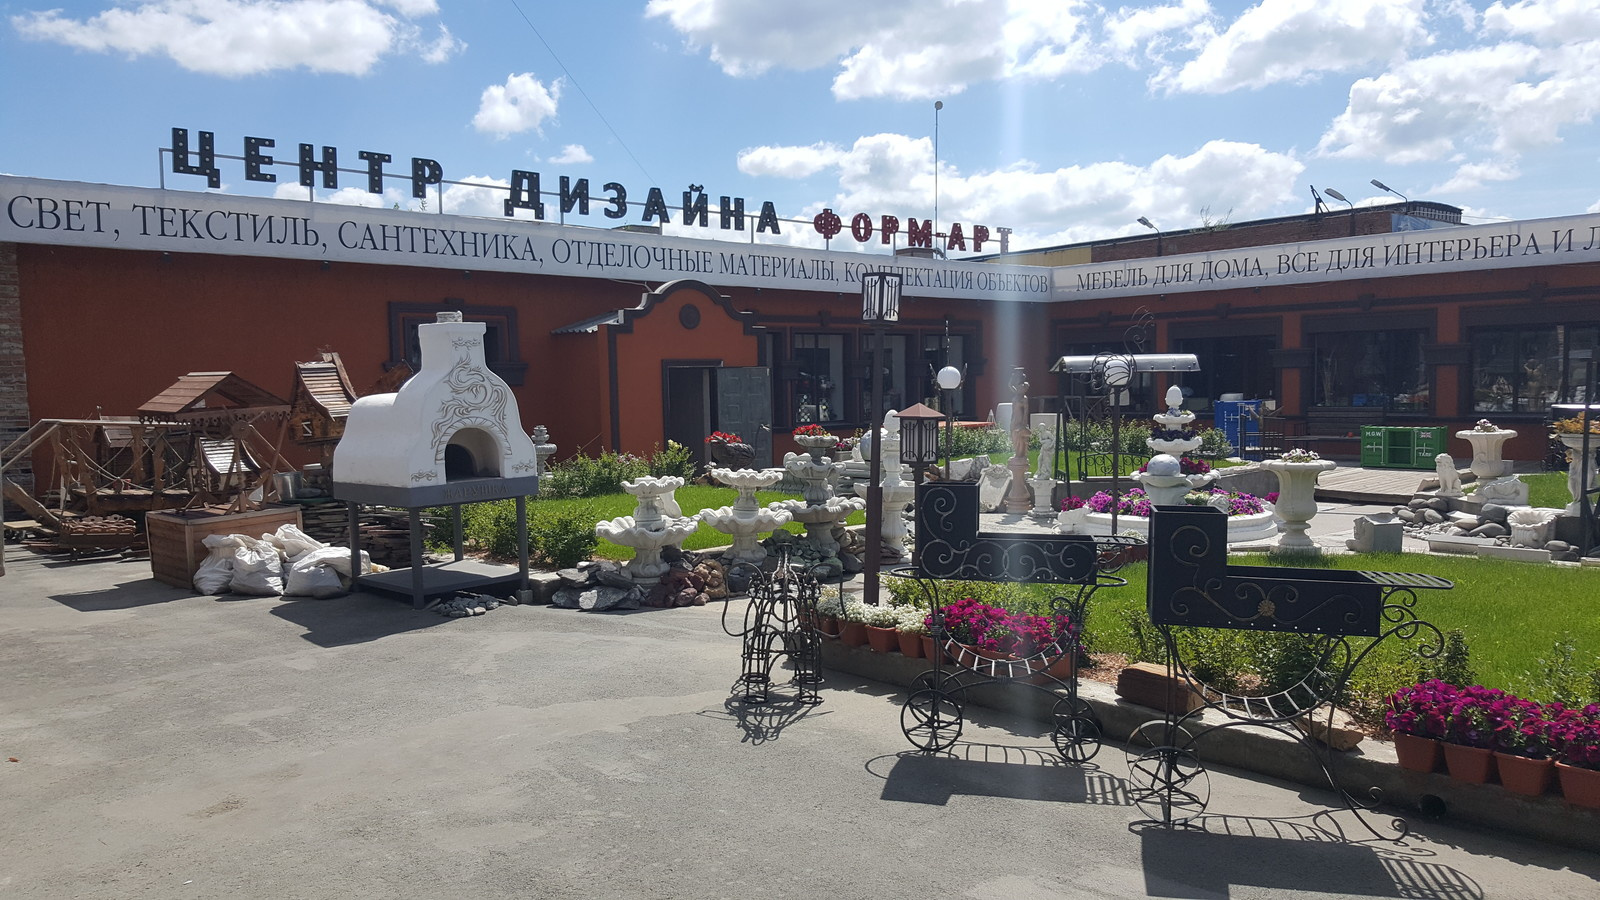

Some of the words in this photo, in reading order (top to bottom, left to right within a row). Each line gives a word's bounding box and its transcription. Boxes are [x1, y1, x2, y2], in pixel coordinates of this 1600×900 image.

[172, 127, 444, 199] ЦЕНТР
[504, 169, 781, 234] ДИЗАЙНА
[813, 208, 1013, 254] ФОРМ-АРТ
[7, 194, 121, 242] СВЕТ,
[131, 202, 329, 255] ТЕКСТИЛЬ,
[337, 220, 544, 268] САНТЕХНИКА,
[551, 238, 713, 274] ОТДЕЛОЧНЫЕ
[719, 252, 839, 287] МАТЕРИАЛЫ,
[976, 271, 1049, 293] ОБЪЕКТОВ
[1076, 267, 1148, 292] МЕБЕЛЬ
[1152, 262, 1194, 289] ДЛЯ
[1198, 257, 1269, 284] ДОМА,
[1276, 251, 1319, 275] ВСЕ
[1325, 246, 1376, 275] ДЛЯ
[1383, 232, 1542, 267] ИНТЕРЬЕРА
[1551, 228, 1575, 254] И
